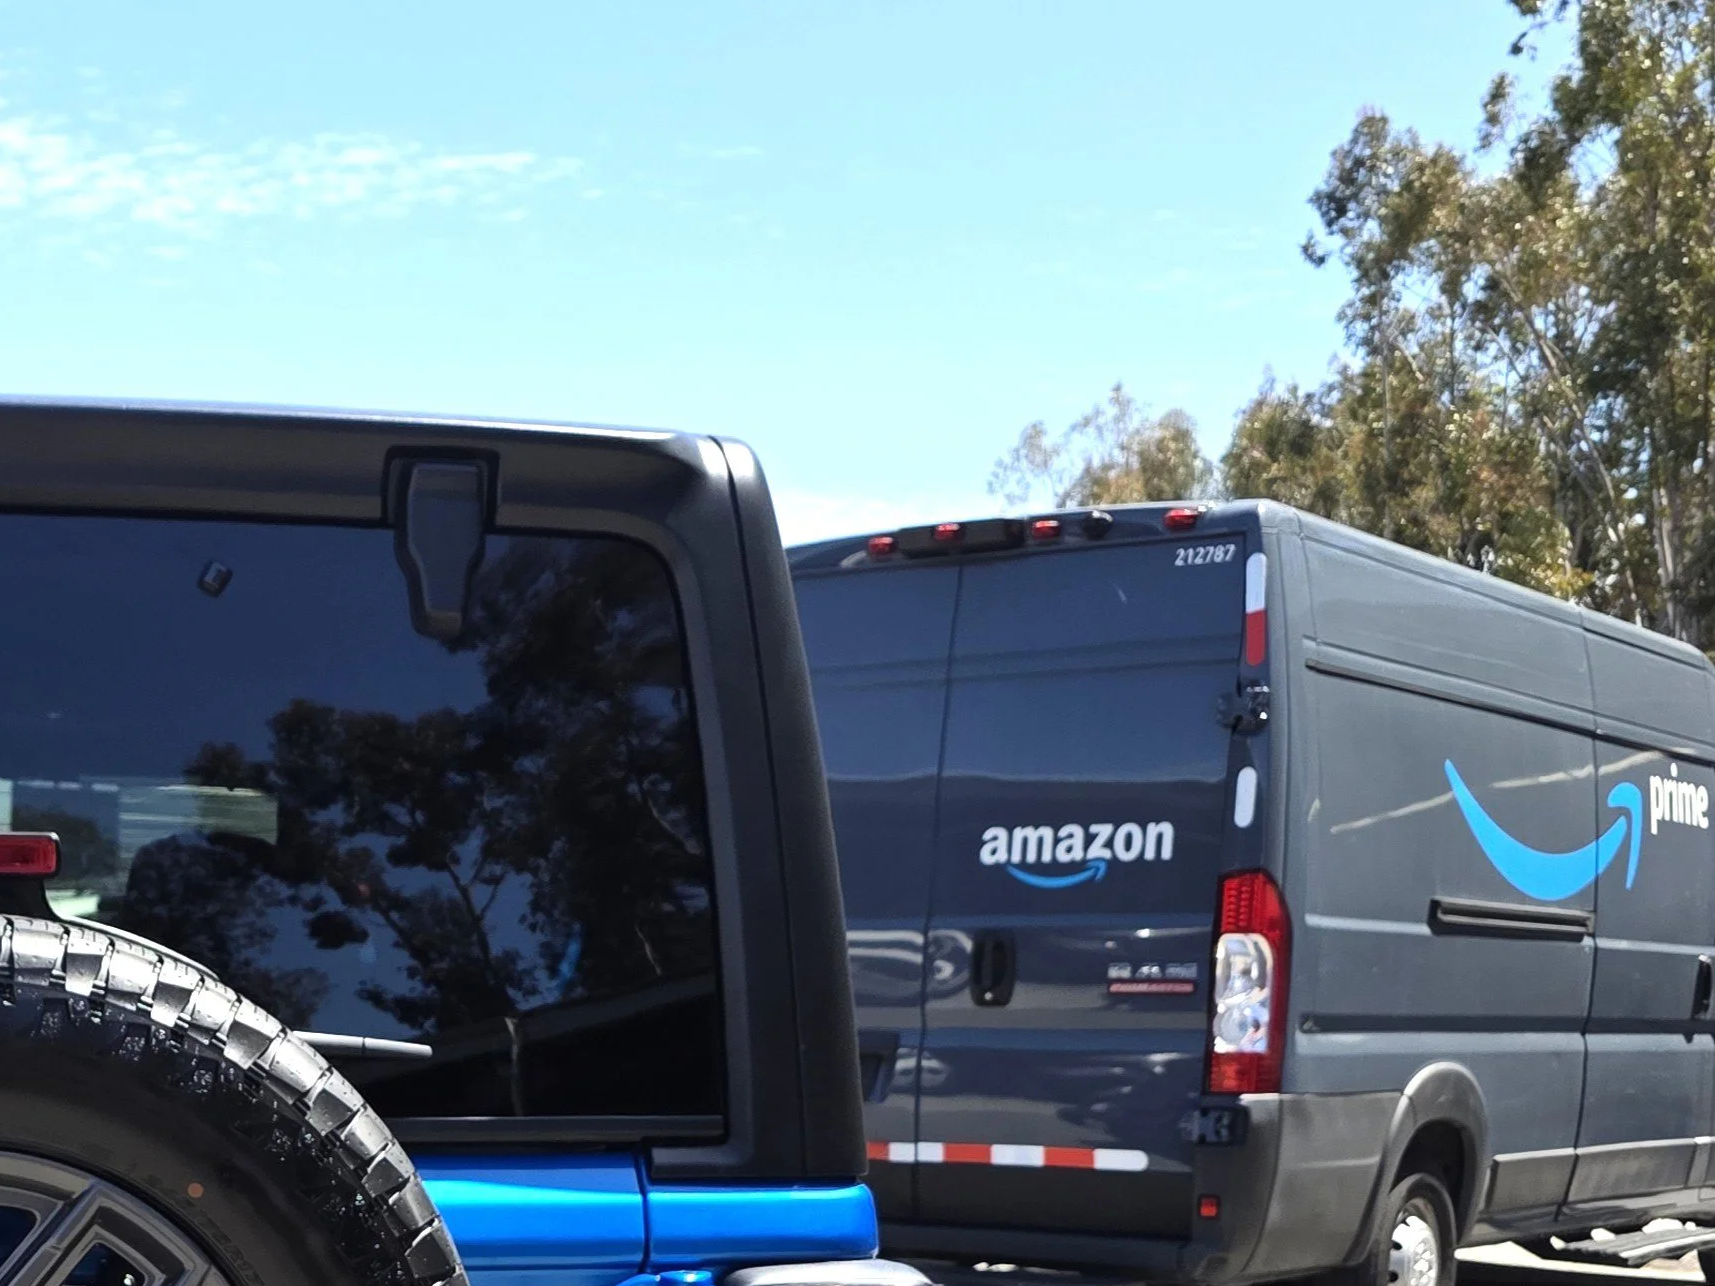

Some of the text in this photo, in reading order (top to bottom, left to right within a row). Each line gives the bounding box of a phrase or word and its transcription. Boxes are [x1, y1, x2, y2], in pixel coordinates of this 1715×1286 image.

[1174, 543, 1236, 567] 212787
[1649, 762, 1709, 836] prime
[979, 821, 1175, 866] amazon
